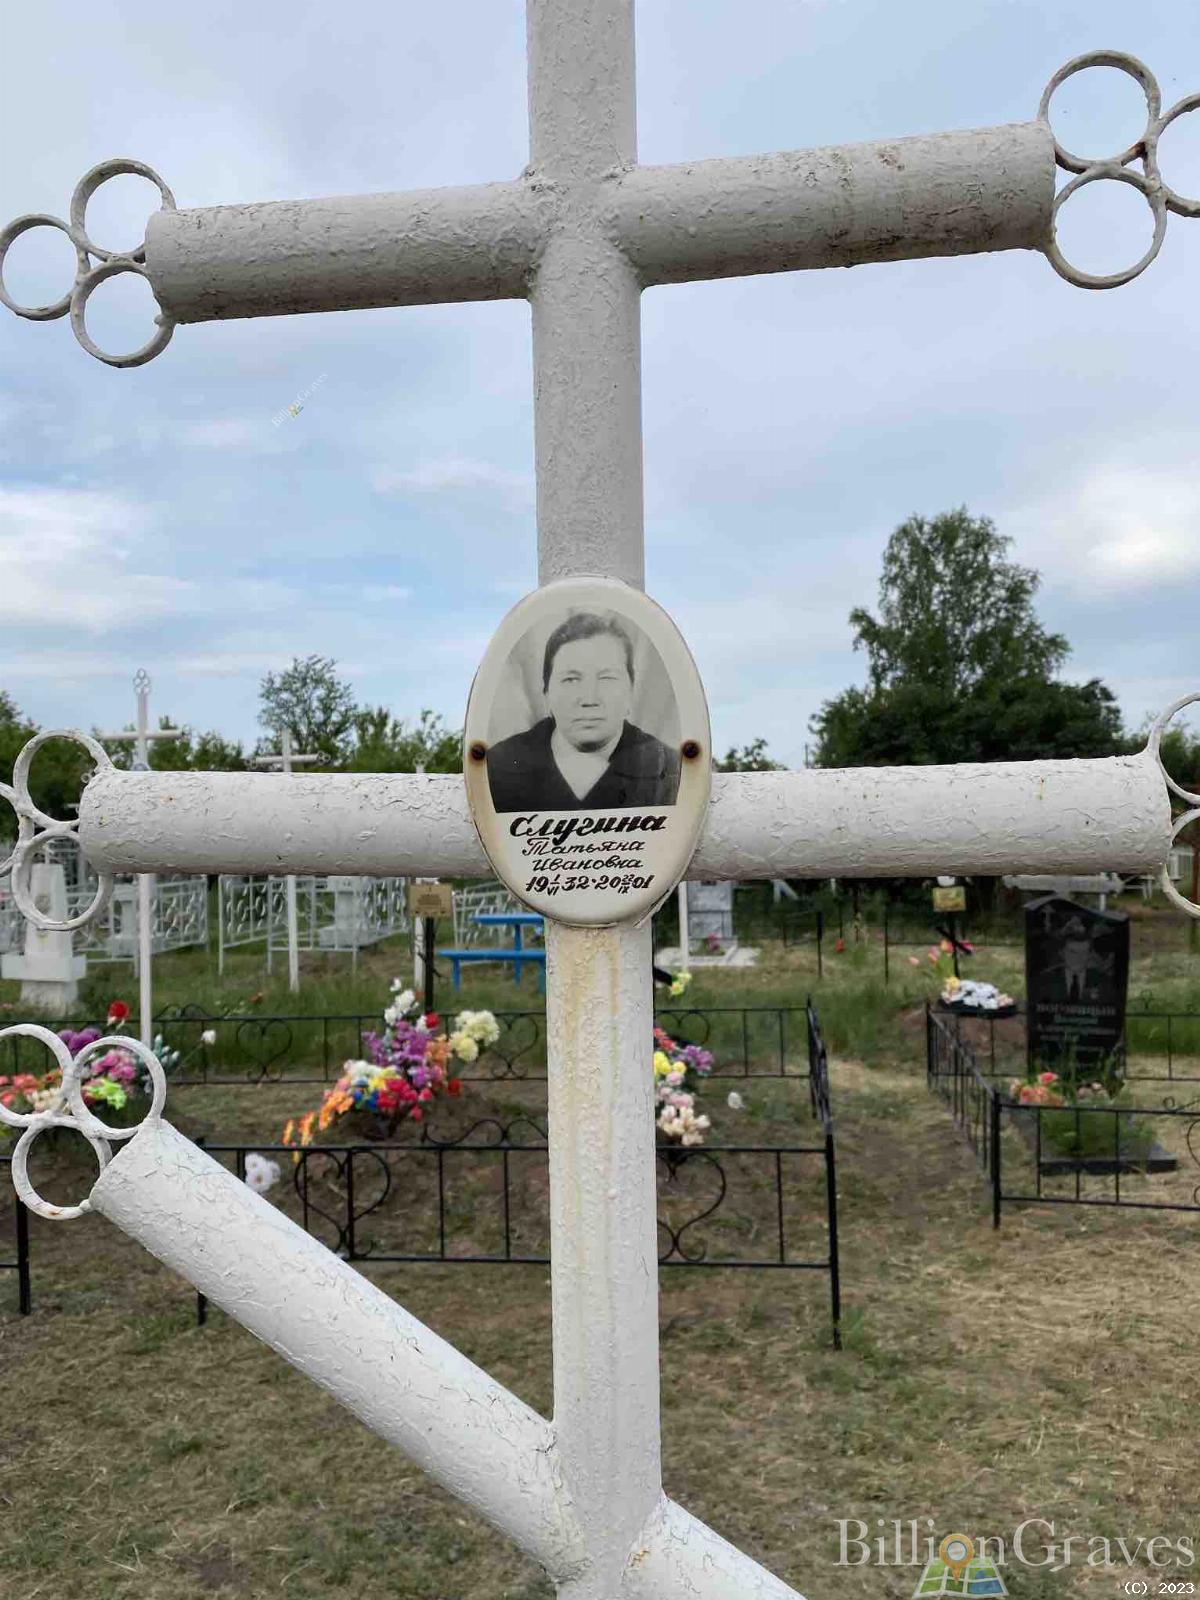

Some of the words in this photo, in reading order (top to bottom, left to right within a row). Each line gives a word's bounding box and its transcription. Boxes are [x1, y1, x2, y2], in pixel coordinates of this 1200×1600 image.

[510, 814, 668, 845] Слугина
[522, 837, 646, 856] Татьяна
[532, 855, 643, 872] Ивановна
